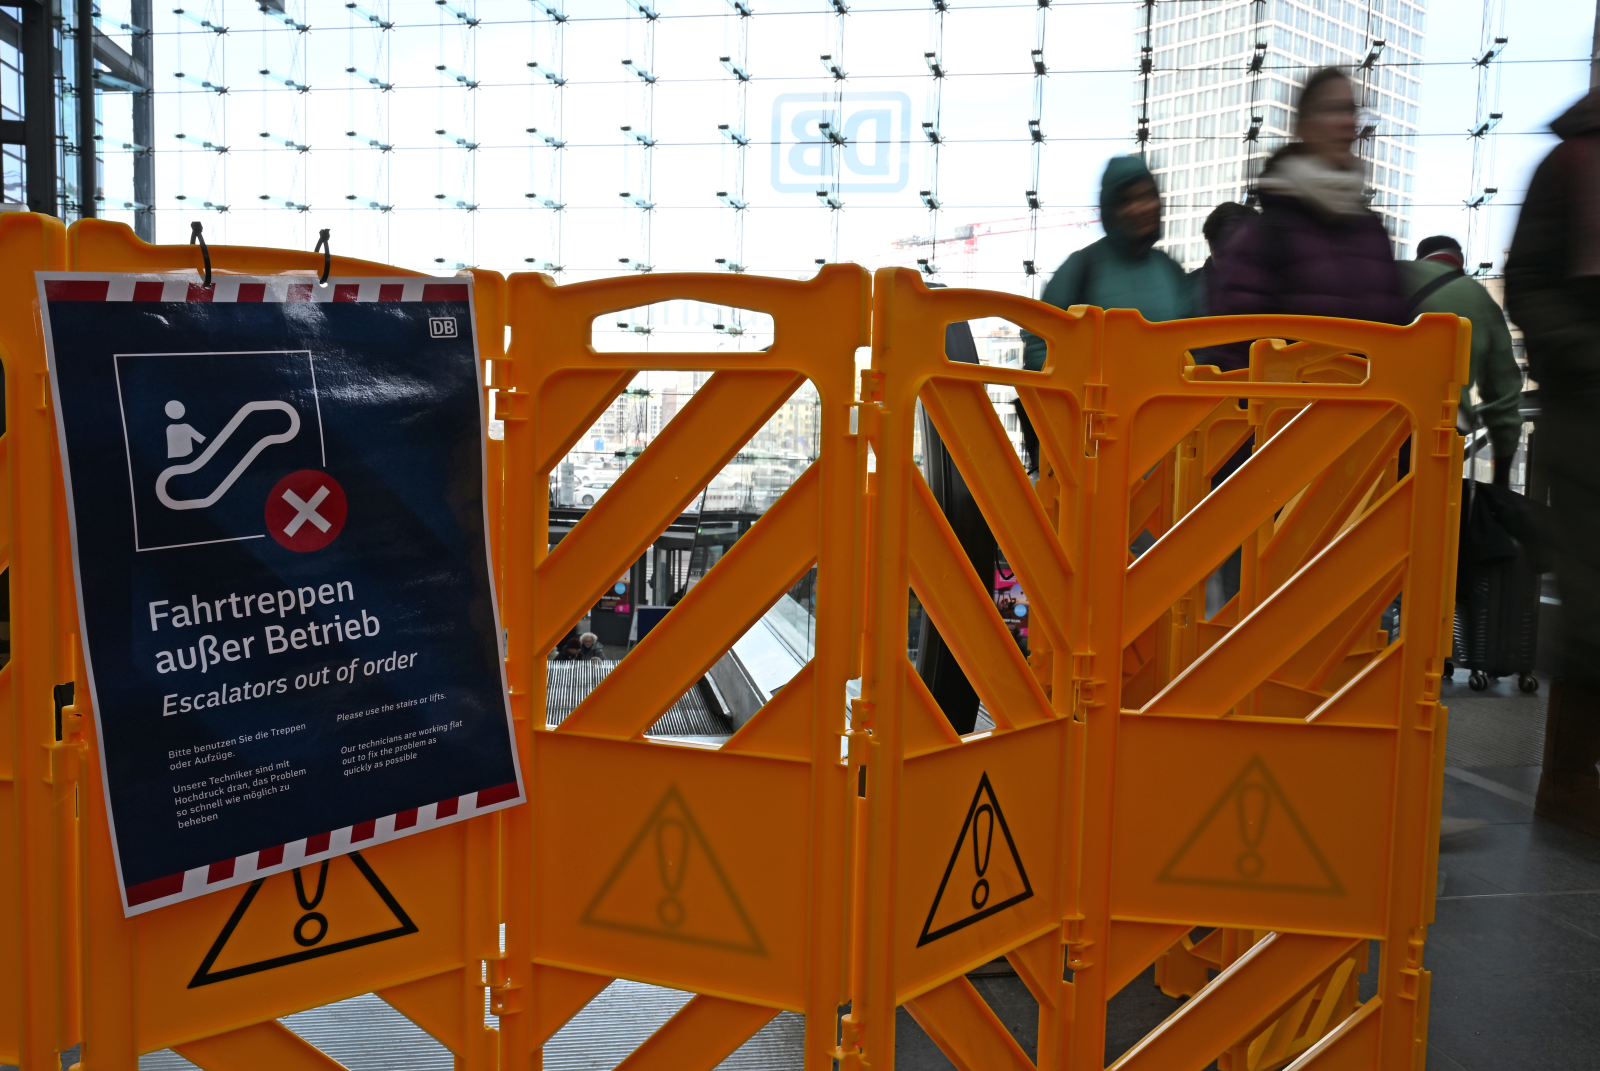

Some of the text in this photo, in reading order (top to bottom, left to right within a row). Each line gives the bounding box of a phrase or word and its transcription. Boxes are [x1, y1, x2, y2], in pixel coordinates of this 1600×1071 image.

[433, 321, 454, 334] DB
[149, 580, 354, 631] Fahrtreppen
[155, 609, 380, 674] außer Betrieb
[163, 651, 418, 716] Escalators out of order
[337, 711, 363, 722] Please
[366, 708, 379, 716] use
[382, 704, 394, 712] the
[396, 699, 418, 709] stairs
[430, 693, 446, 702] lifts.
[168, 724, 306, 758] Bitte benutzen Sie die Treppen
[341, 746, 356, 754] Our
[359, 735, 402, 751] technicians
[419, 723, 448, 736] working
[449, 720, 462, 730] flat
[342, 757, 355, 765] out
[368, 751, 378, 760] fix
[381, 747, 393, 756] the
[395, 740, 426, 753] problem
[170, 751, 235, 770] oder Aufzüge.
[173, 760, 290, 794] Unsere Techniker sind mit
[344, 752, 417, 777] quickly as possible
[174, 768, 306, 805] Hochdruck dran, das Problem
[176, 784, 290, 817] so schnell wie möglich zu
[178, 813, 218, 828] beheben
